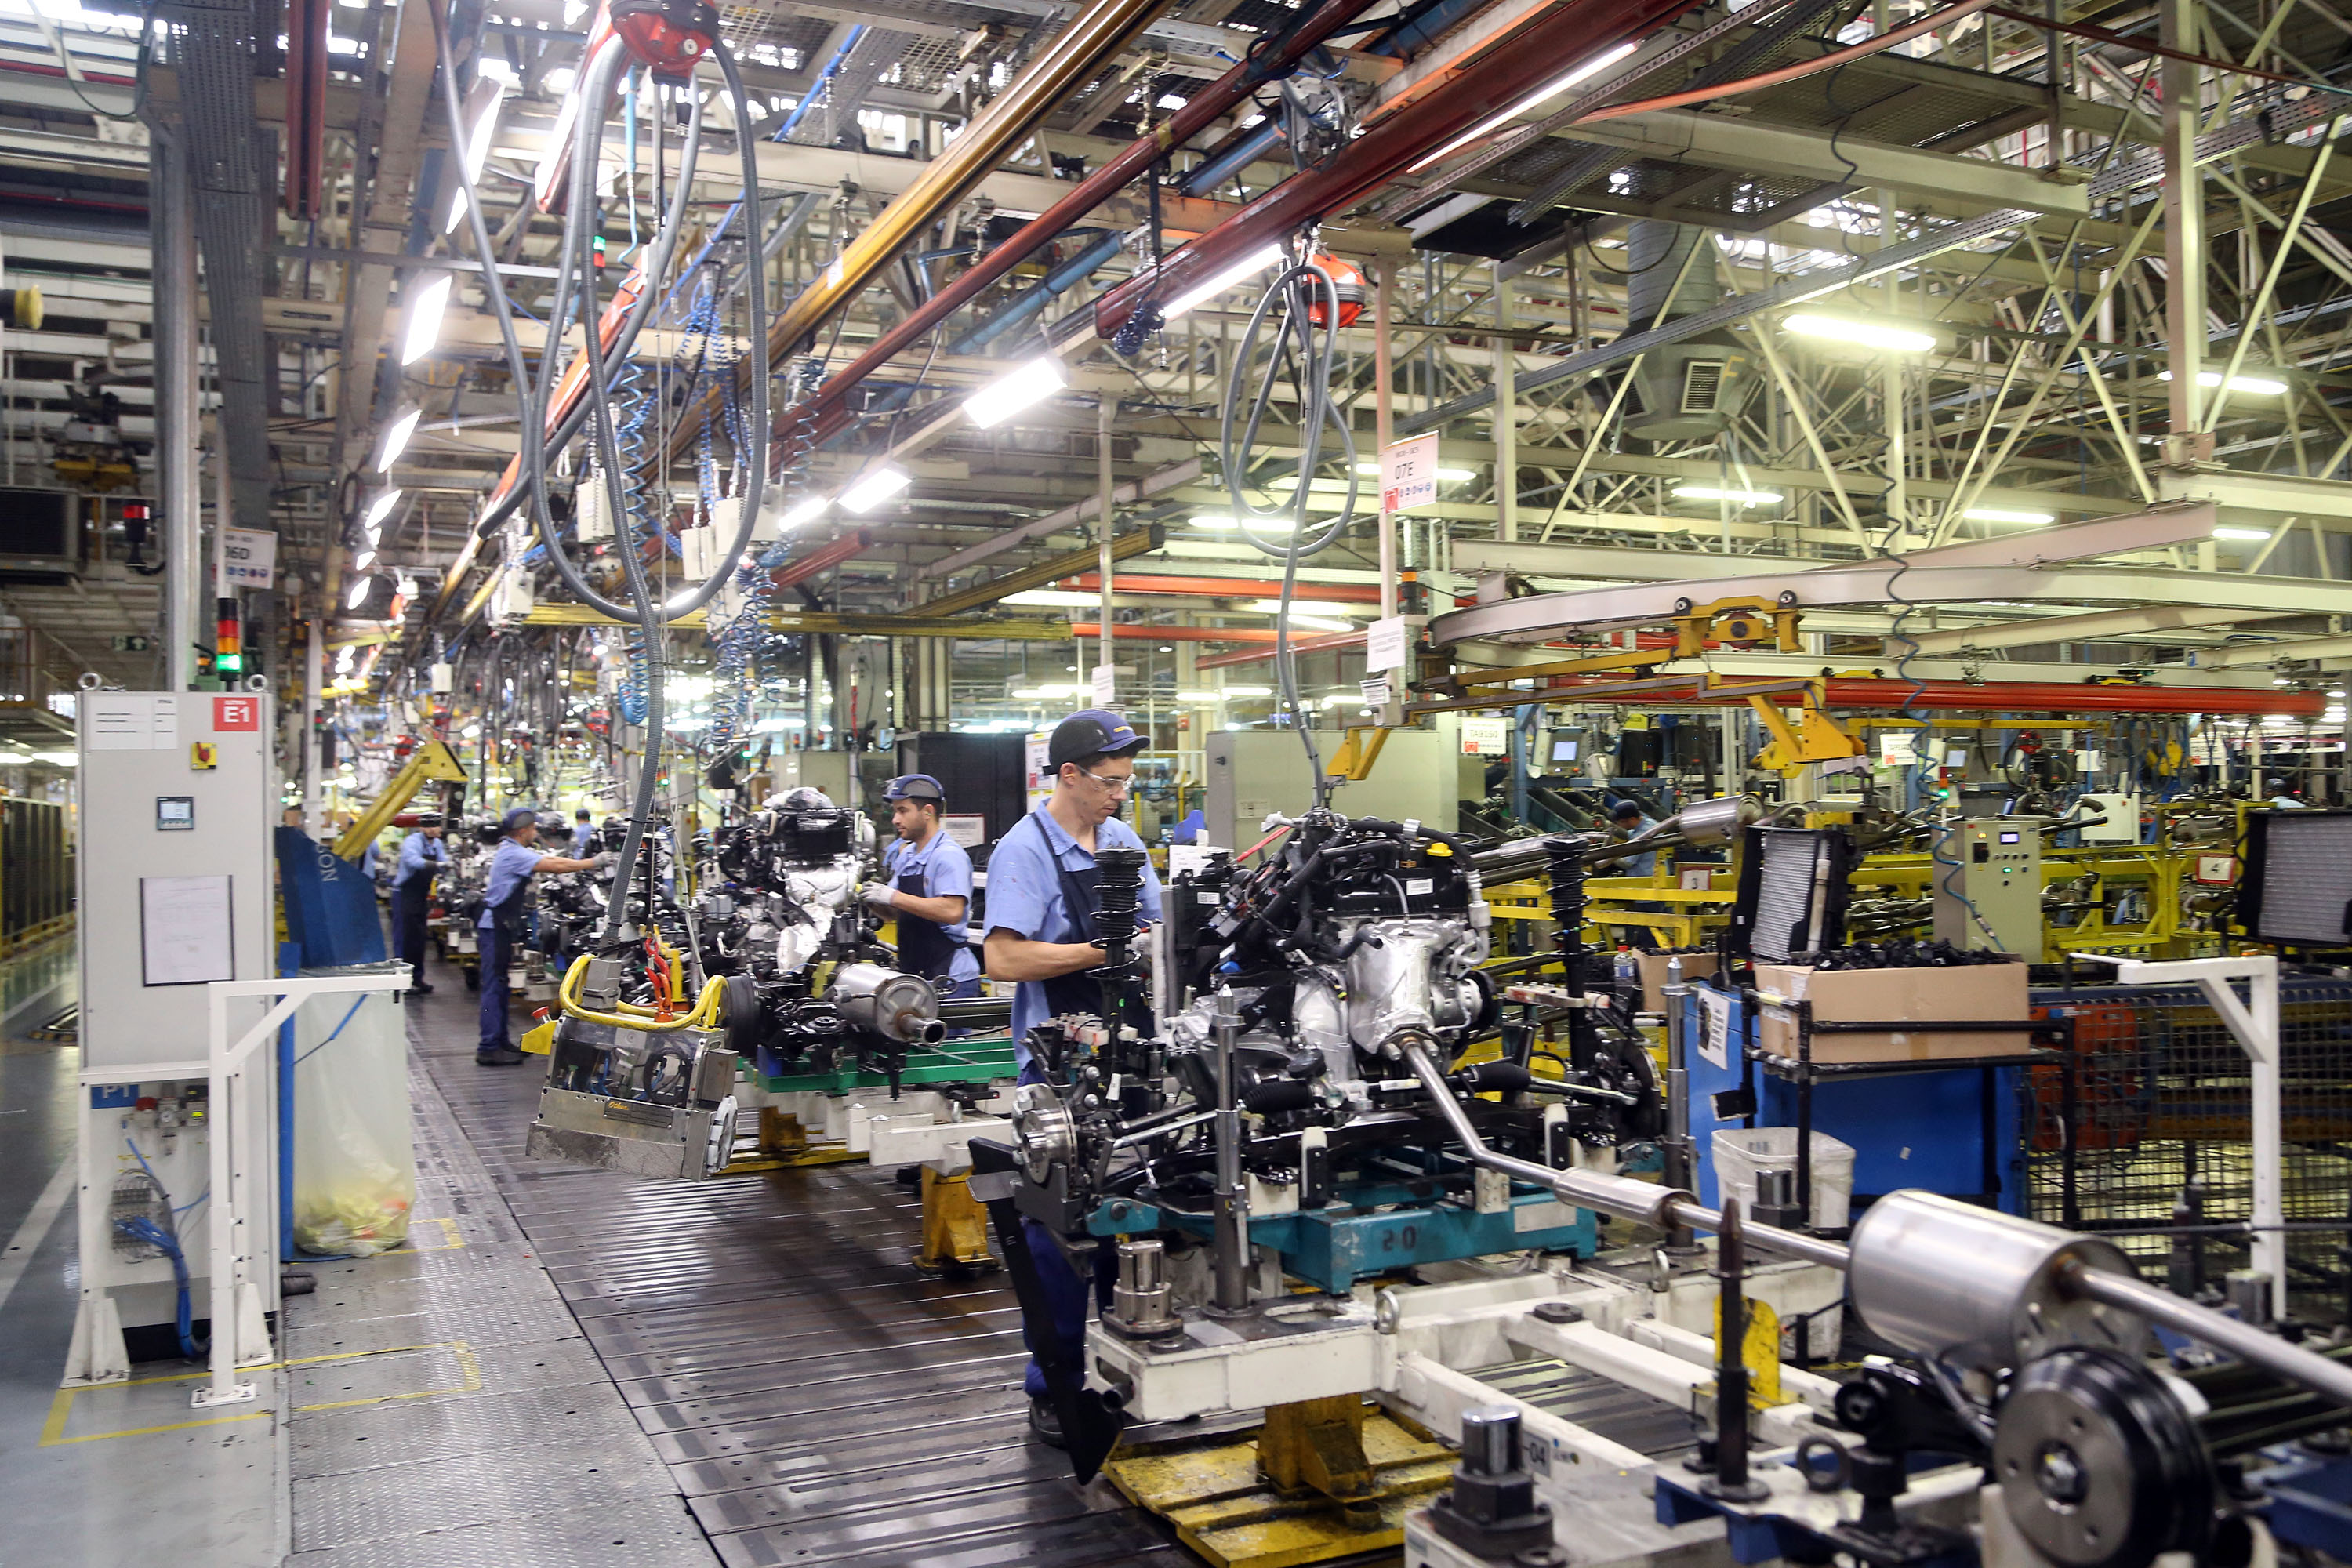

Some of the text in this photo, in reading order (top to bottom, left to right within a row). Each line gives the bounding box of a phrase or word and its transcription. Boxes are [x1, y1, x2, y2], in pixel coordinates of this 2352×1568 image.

[1395, 461, 1414, 480] 07E
[223, 706, 250, 723] E1
[2210, 862, 2220, 874] 4
[1691, 877, 1699, 890] 3
[103, 1084, 129, 1099] P1
